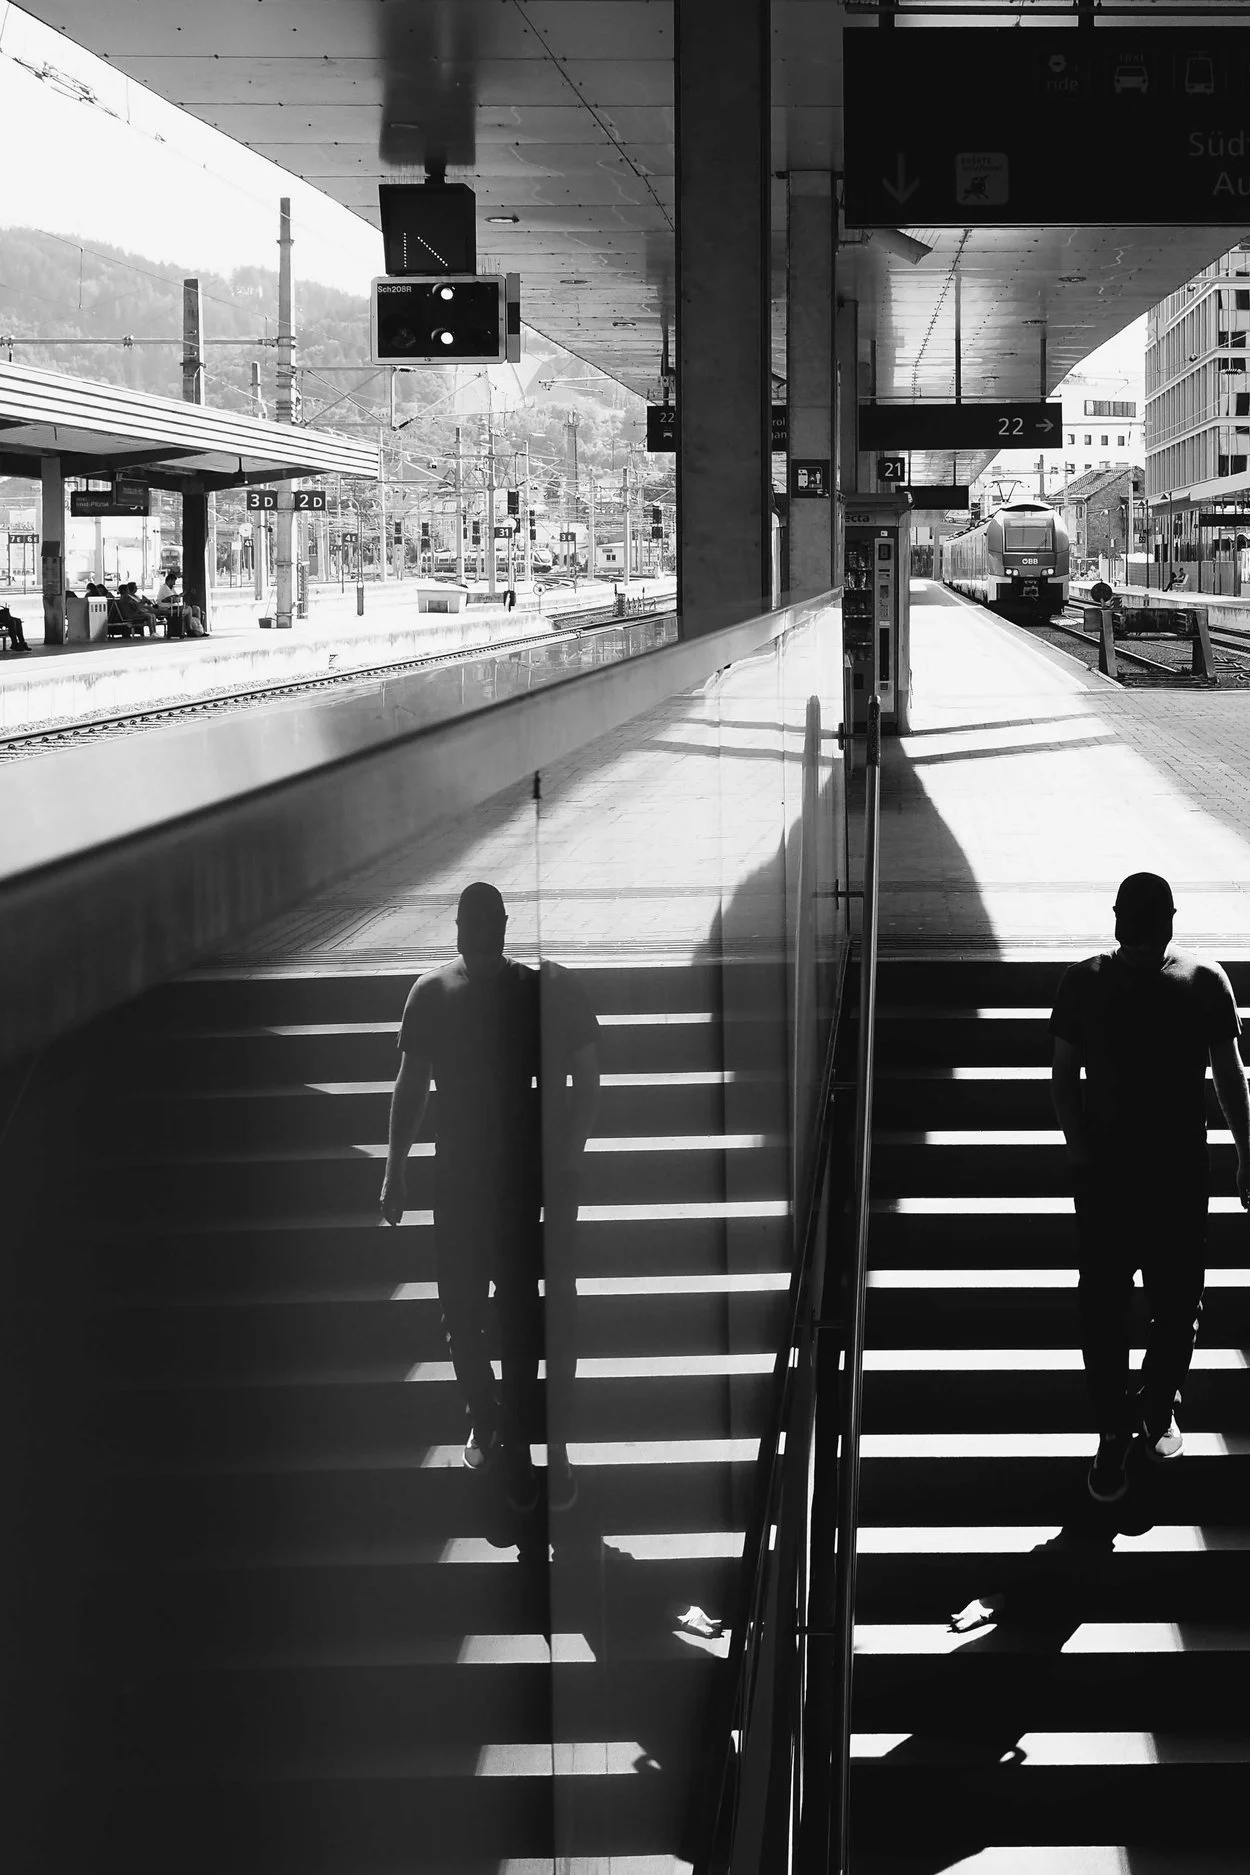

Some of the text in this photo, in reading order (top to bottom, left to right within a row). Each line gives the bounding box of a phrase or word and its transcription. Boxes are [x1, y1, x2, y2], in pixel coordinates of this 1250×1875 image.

[1046, 76, 1079, 92] ride
[659, 412, 675, 423] 22
[998, 417, 1024, 435] 22
[884, 462, 901, 477] 21
[499, 529, 509, 537] 31
